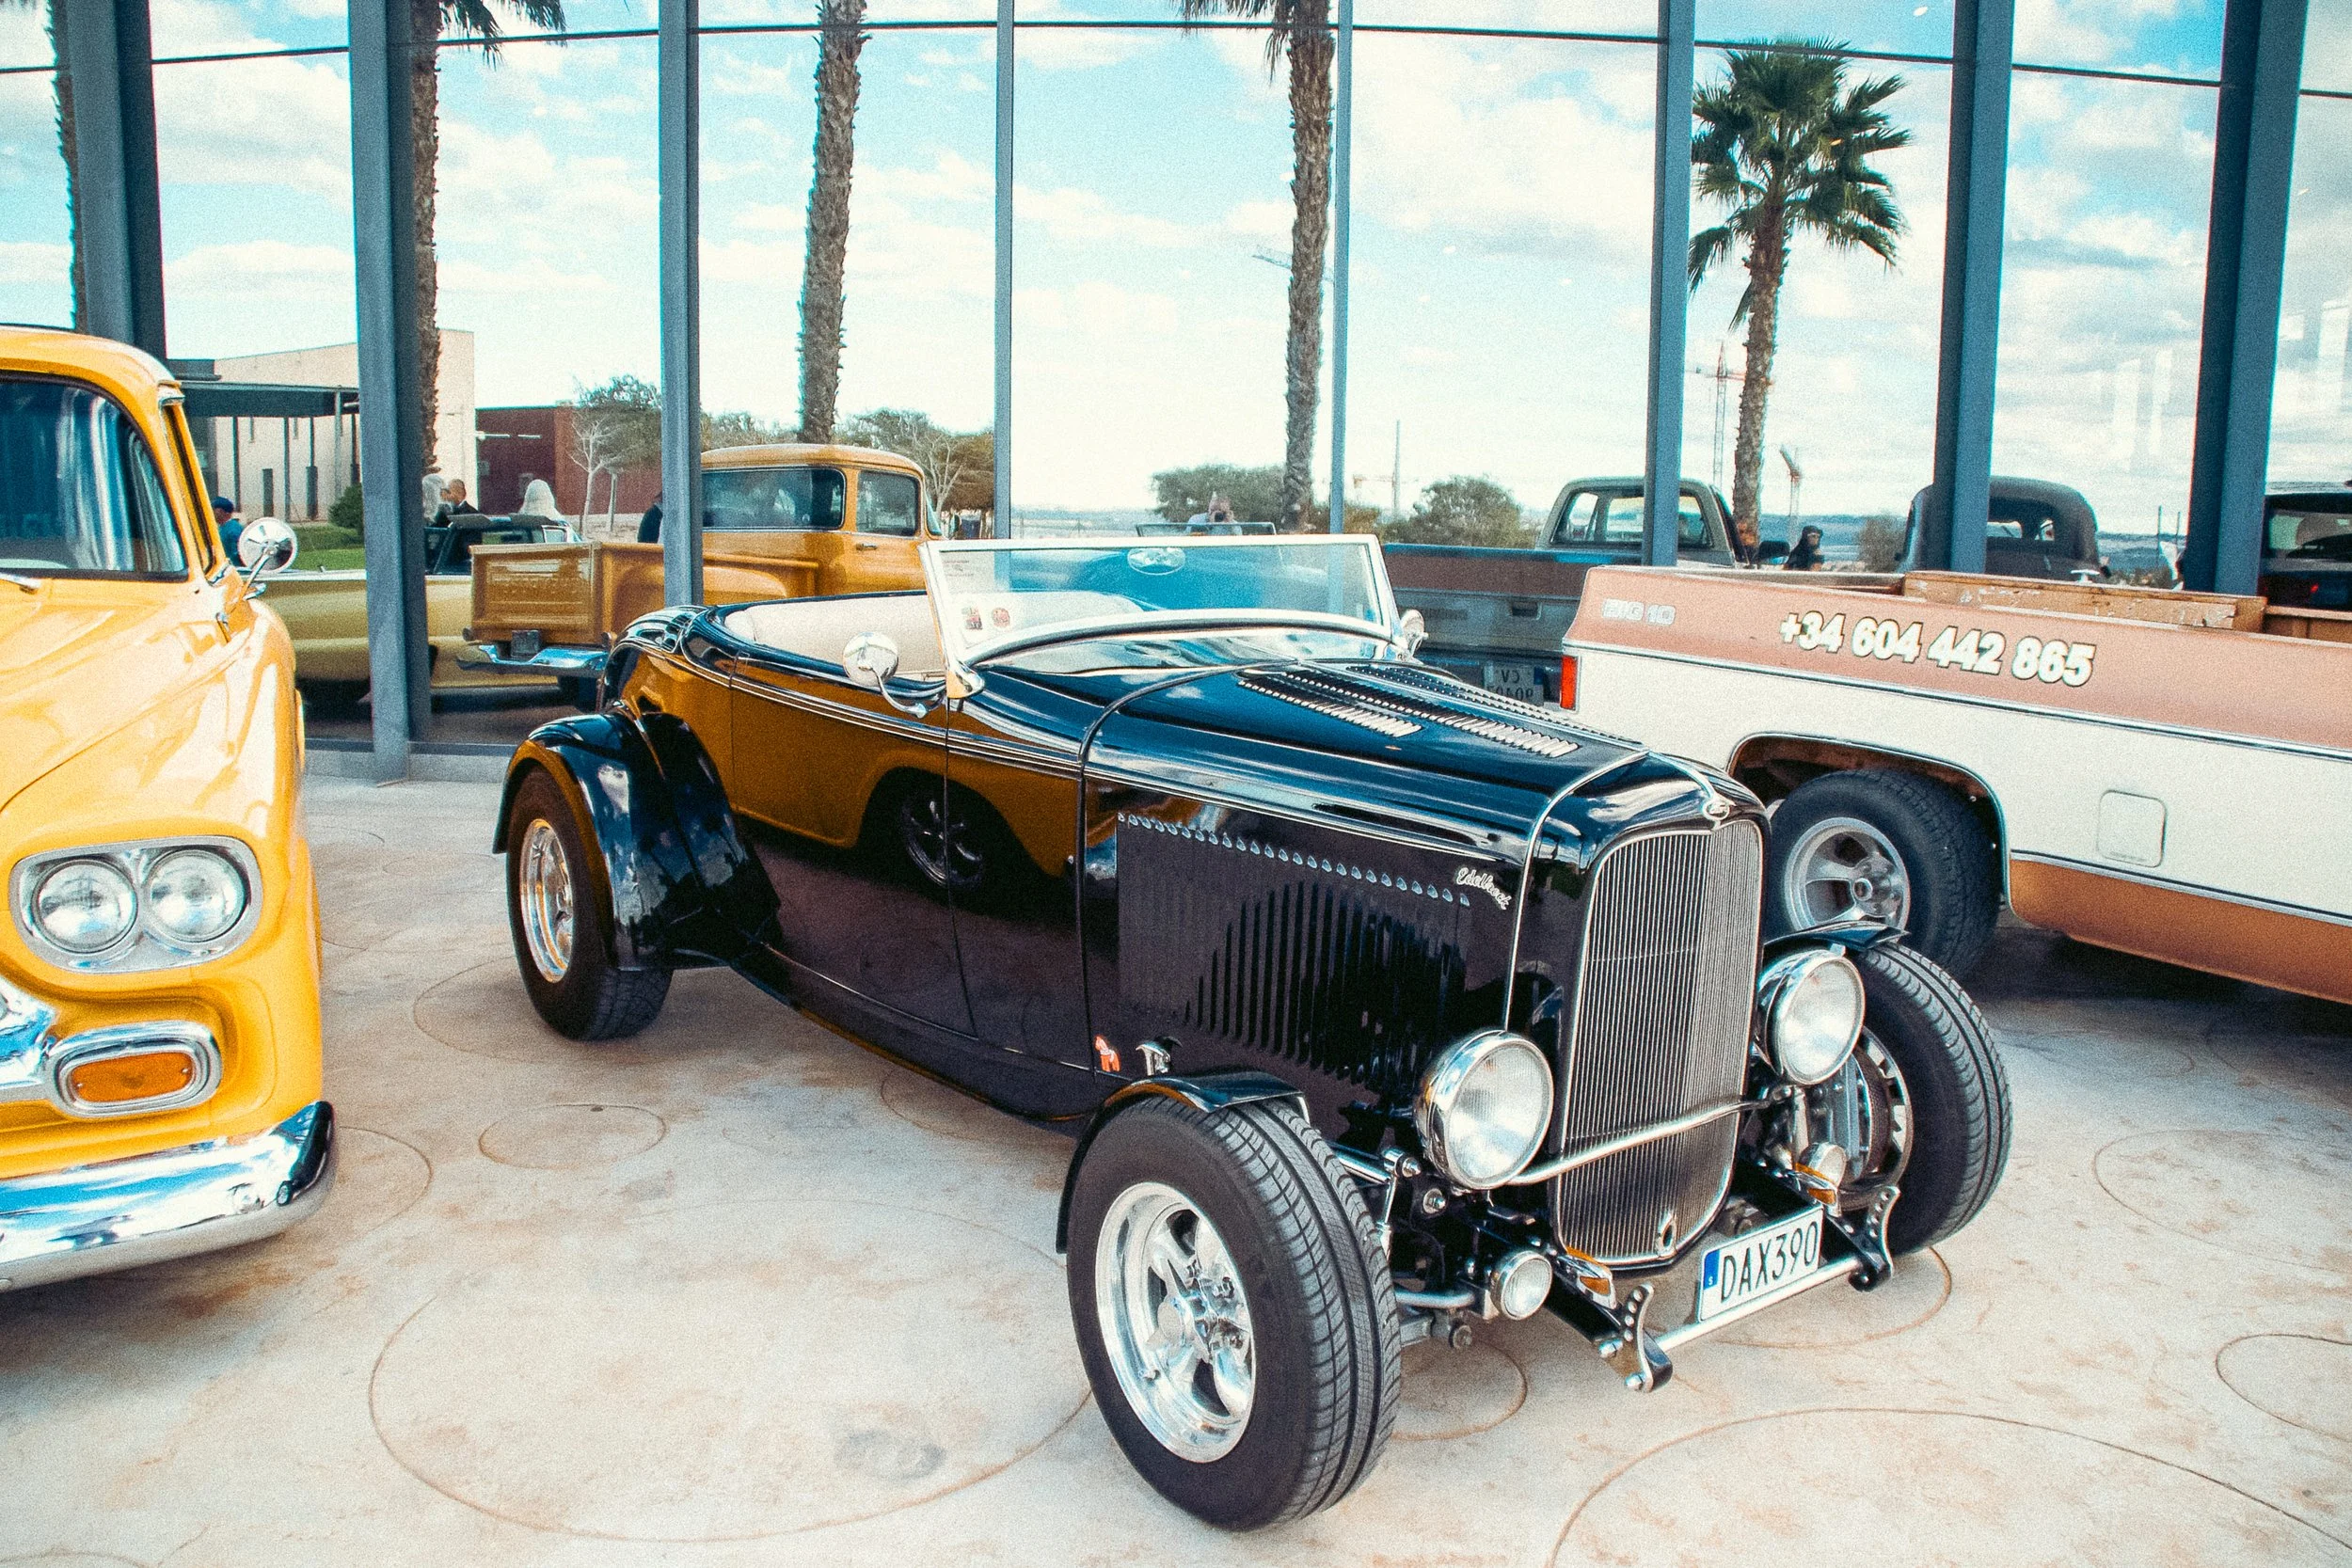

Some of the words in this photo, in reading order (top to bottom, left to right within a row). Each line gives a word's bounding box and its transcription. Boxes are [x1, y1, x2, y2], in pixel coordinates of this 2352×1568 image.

[1601, 597, 1645, 622] BIG
[1646, 603, 1677, 626] 10
[1779, 610, 1846, 654] +34
[1851, 616, 1923, 664] 604
[1927, 625, 2007, 675] 442
[2011, 635, 2096, 688] 865
[1455, 866, 1512, 910] Edelbrock
[1721, 1221, 1818, 1303] DAX390
